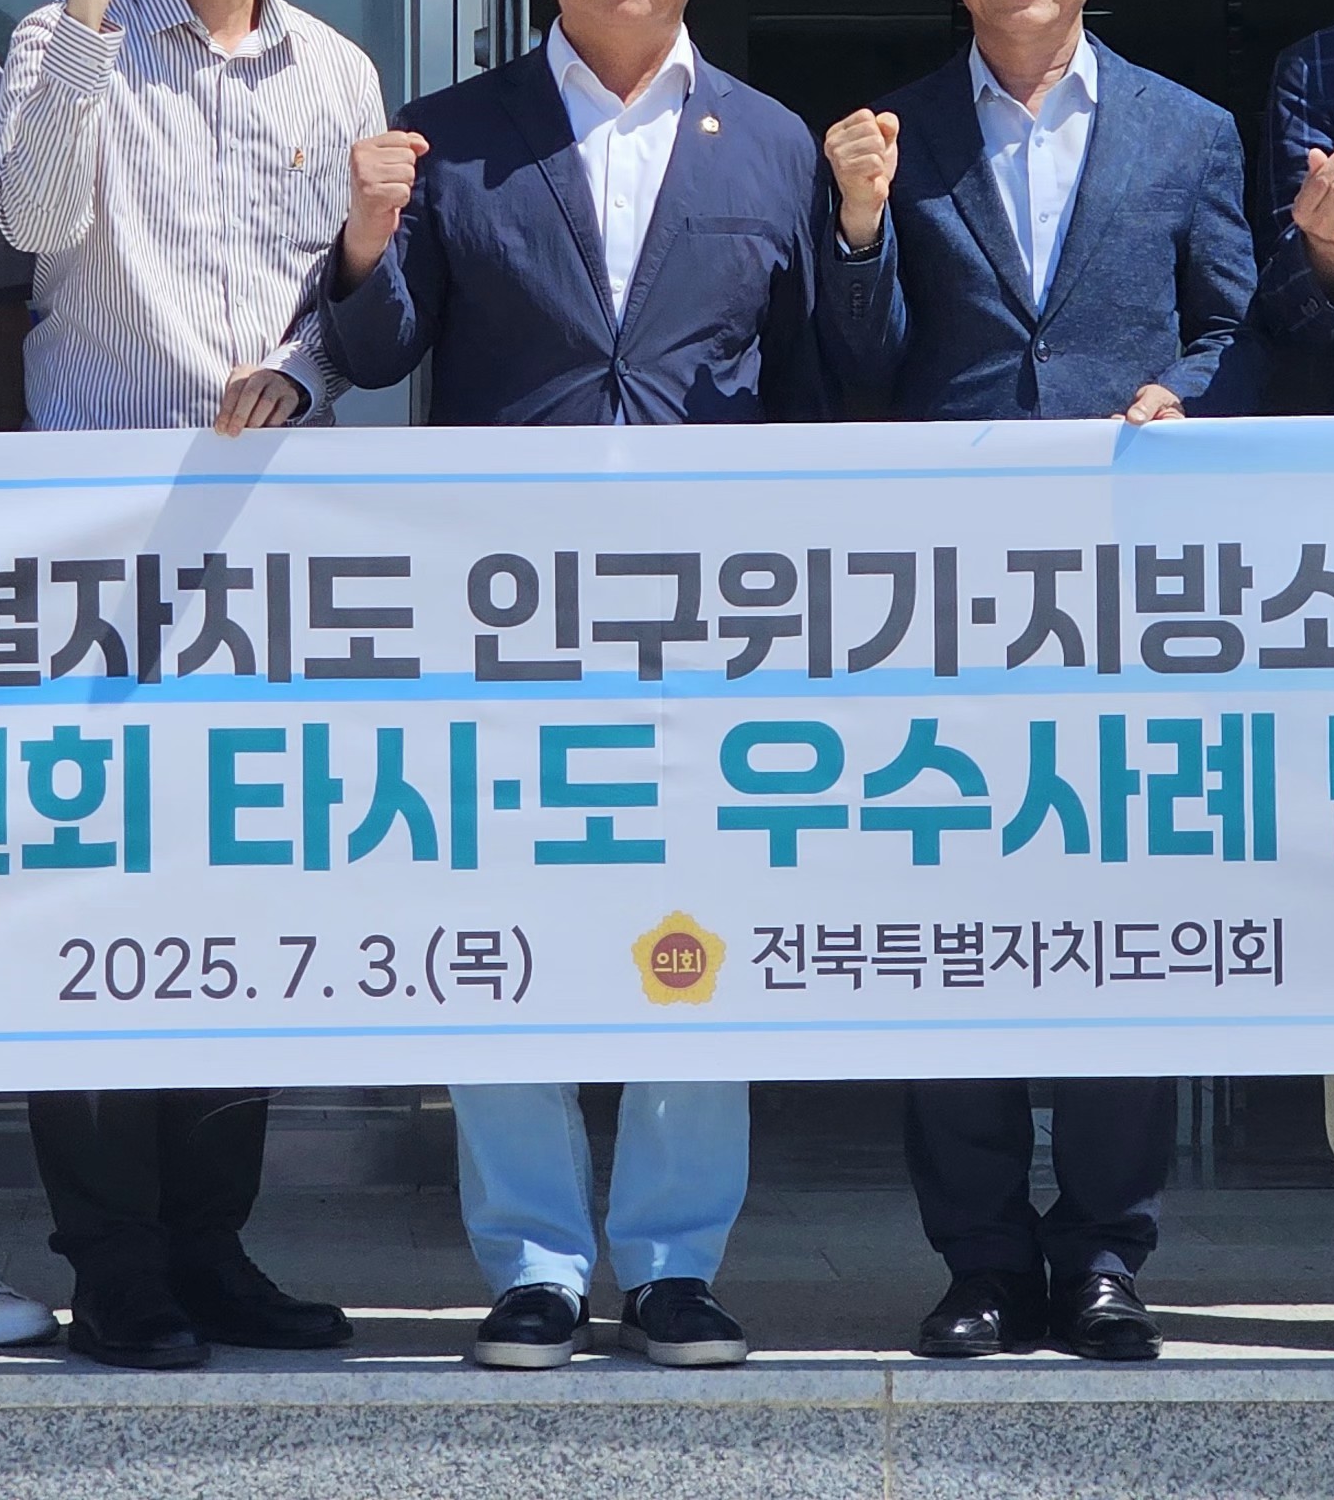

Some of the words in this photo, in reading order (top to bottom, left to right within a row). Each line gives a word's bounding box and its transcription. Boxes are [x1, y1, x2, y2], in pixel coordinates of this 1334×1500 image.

[208, 722, 666, 871] 타시·도
[716, 713, 1278, 868] 우수사례
[59, 936, 258, 1001] 2025.
[278, 935, 334, 999] 7.
[357, 925, 533, 1005] 3.(목)
[653, 948, 702, 973] 의회
[750, 917, 1285, 991] 전북특별자치도의회
